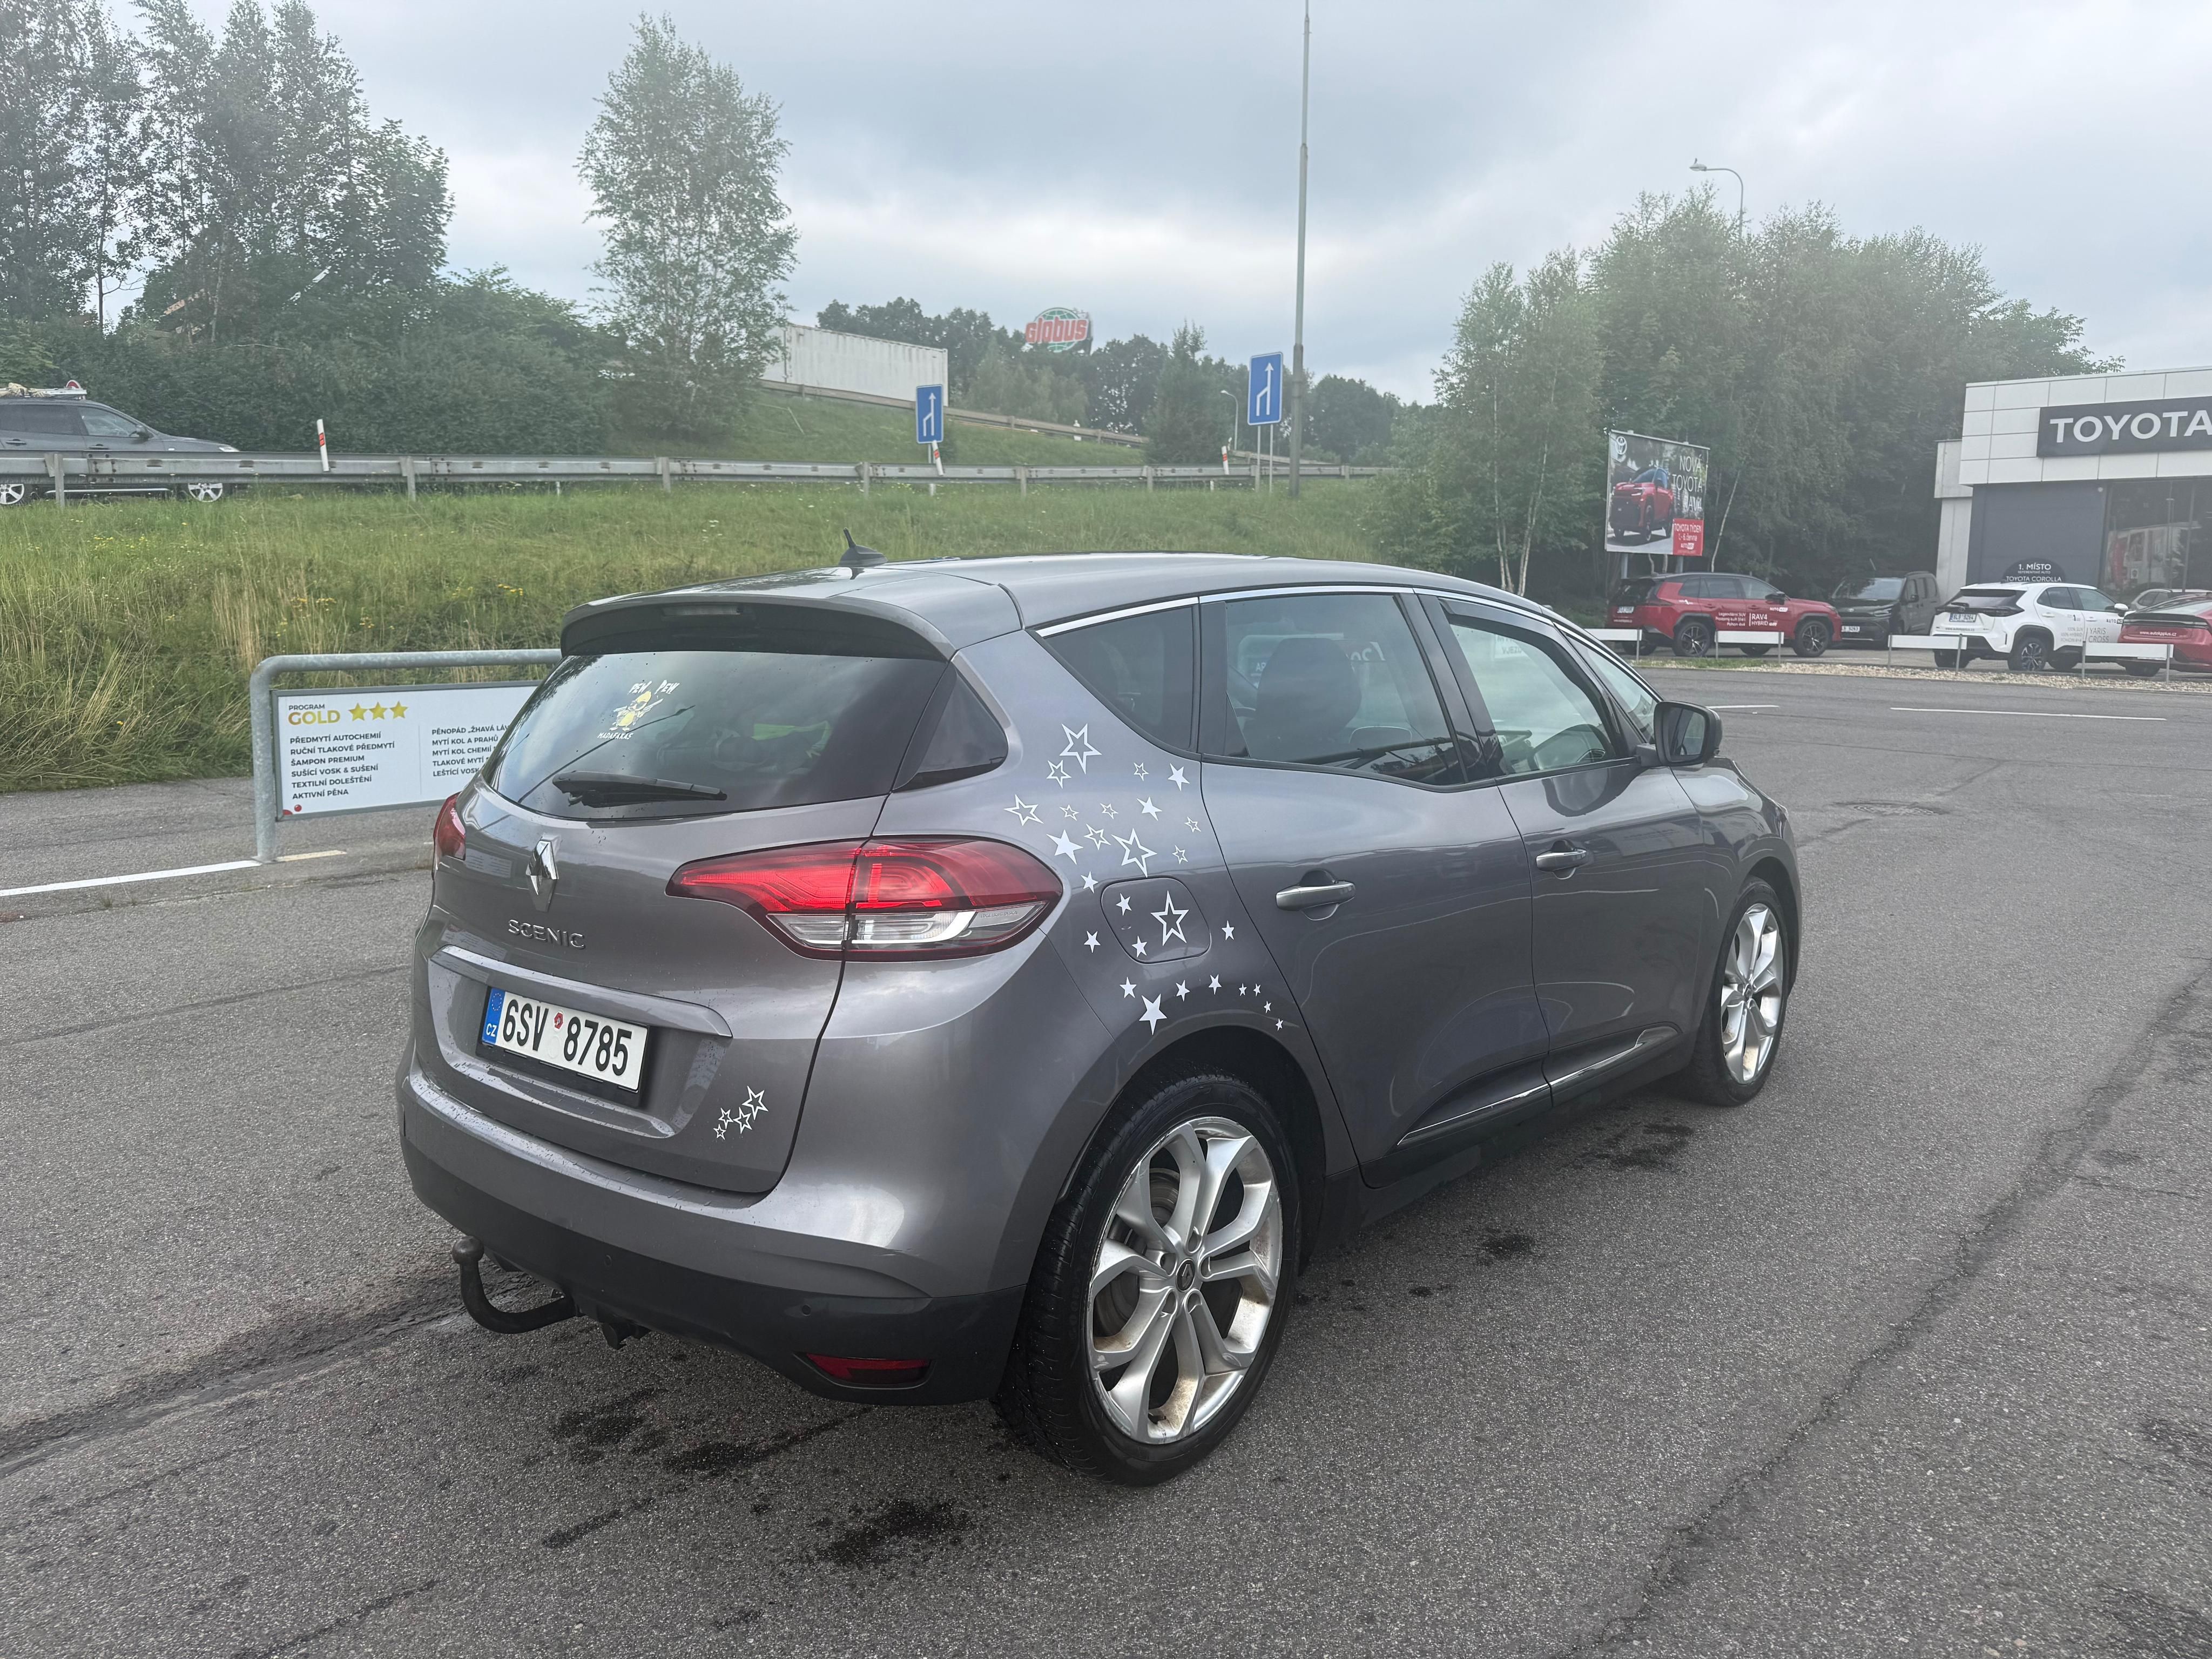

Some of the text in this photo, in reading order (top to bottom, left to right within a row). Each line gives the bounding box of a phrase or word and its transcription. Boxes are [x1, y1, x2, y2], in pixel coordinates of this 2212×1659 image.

[1025, 316, 1089, 343] Globus
[2049, 410, 2212, 443] TOYOTA
[1680, 454, 1702, 472] NOVÁ
[1672, 474, 1702, 493] TOYOTA
[1674, 523, 1689, 532] TOYOTA
[2026, 562, 2052, 570] MÍSTO
[628, 679, 680, 695] PEW PEW
[288, 710, 340, 725] GOLD
[290, 731, 381, 744] PŘEDMYTÍ AUTOCHEMIÍ
[432, 726, 466, 736] PĚNOPÁD
[597, 732, 635, 740] MADAFAKAS
[432, 737, 449, 746] MYTÍ
[474, 734, 498, 743] PRAHŮ
[291, 741, 395, 755] RUČNÍ TLAKOVÉ PŘEDMYTÍ
[432, 747, 449, 756] MYTÍ
[467, 745, 491, 753] CHEMIÍ
[291, 755, 365, 766] ŠAMPON PREMIUM
[433, 757, 466, 766] TLAKOVÉ
[468, 756, 484, 764] MYTÍ
[291, 768, 317, 777] SUŠÍCÍ
[350, 764, 379, 773] SUŠENÍ
[433, 768, 458, 777] LEŠTÍCÍ
[292, 774, 372, 788] TEXTILNÍ DOLEŠTĚNÍ
[292, 788, 349, 799] AKTIVNÍ PĚNA
[508, 919, 585, 949] SCENIC
[486, 1023, 497, 1037] CZ
[503, 999, 632, 1076] 6SV 8785
